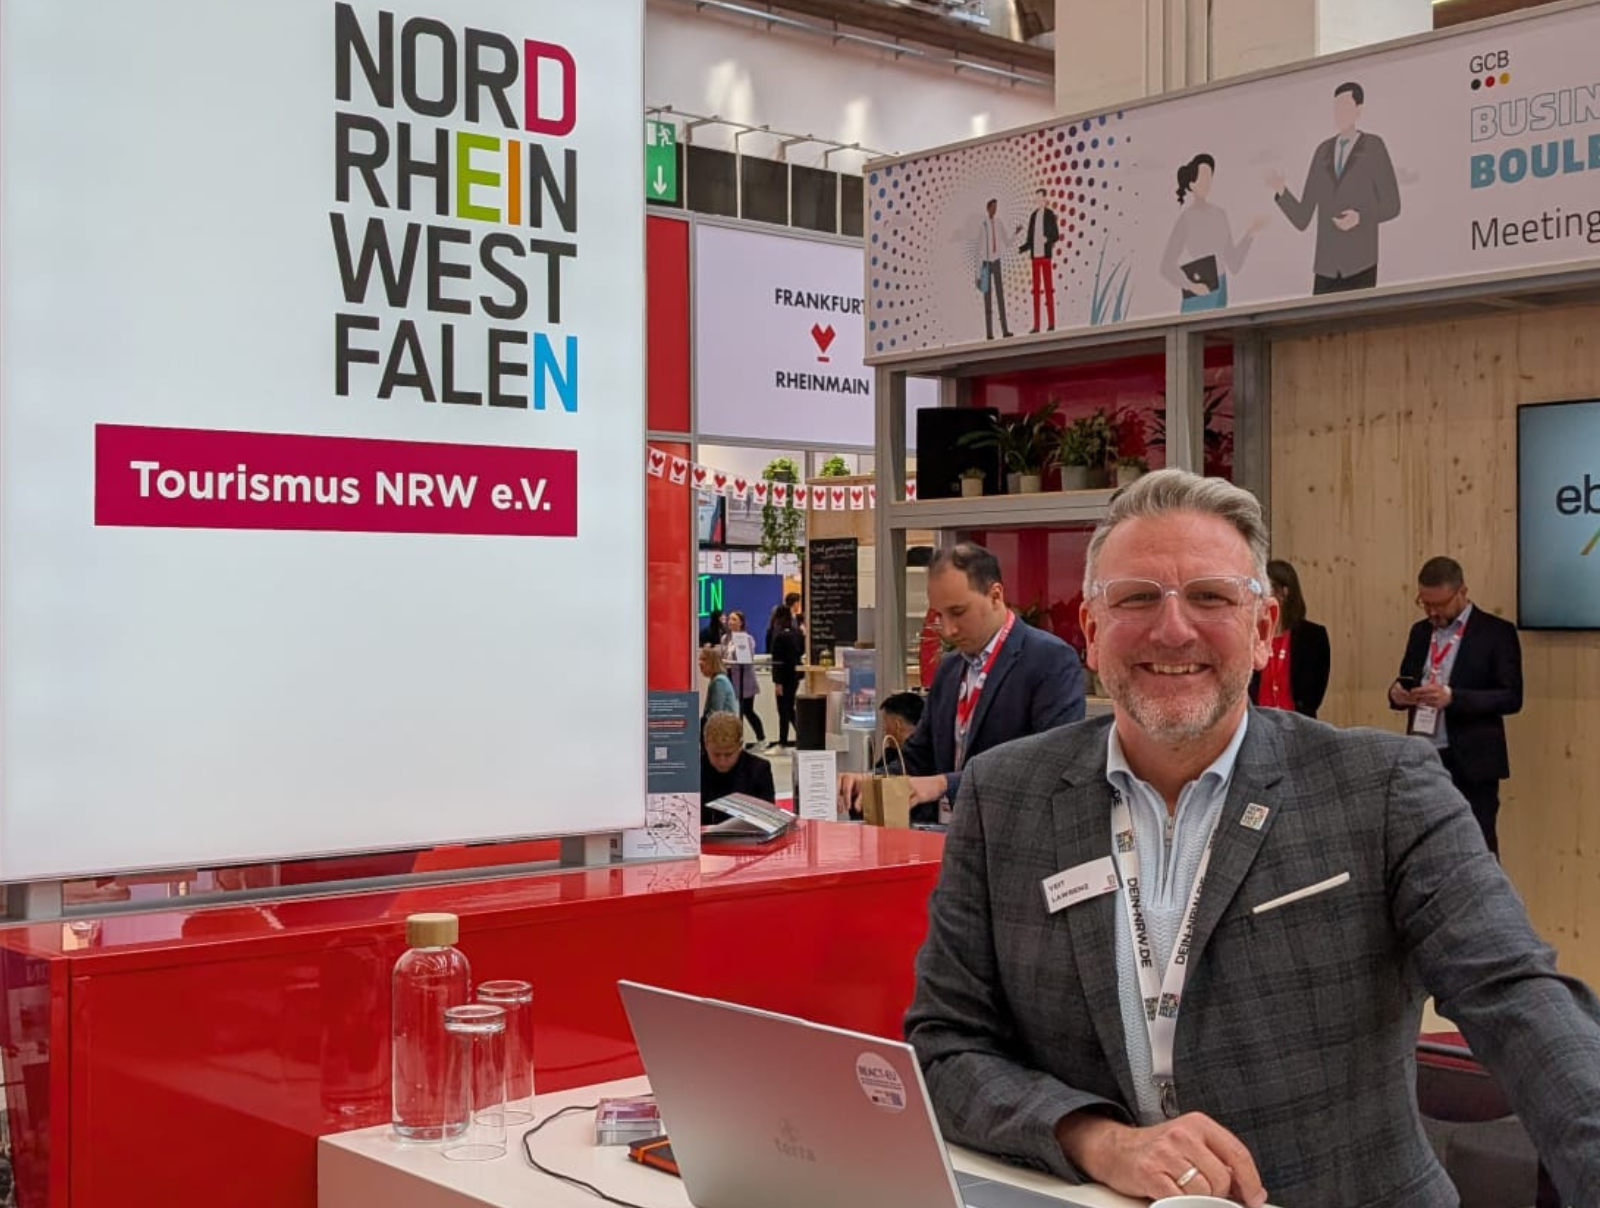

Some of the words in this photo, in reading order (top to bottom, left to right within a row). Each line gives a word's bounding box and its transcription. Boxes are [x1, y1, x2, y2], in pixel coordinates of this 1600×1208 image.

[335, 1, 577, 137] NORD
[1469, 50, 1509, 74] GCB
[335, 111, 577, 233] RHEIN
[329, 212, 577, 324] WEST
[1472, 208, 1600, 250] Meeting
[335, 313, 578, 412] FALEN
[775, 370, 870, 395] RHEINMAIN
[130, 460, 360, 504] Tourismus
[375, 471, 478, 508] NRW
[490, 478, 551, 511] e.V.
[1127, 877, 1152, 968] DEIN-NRW.DE
